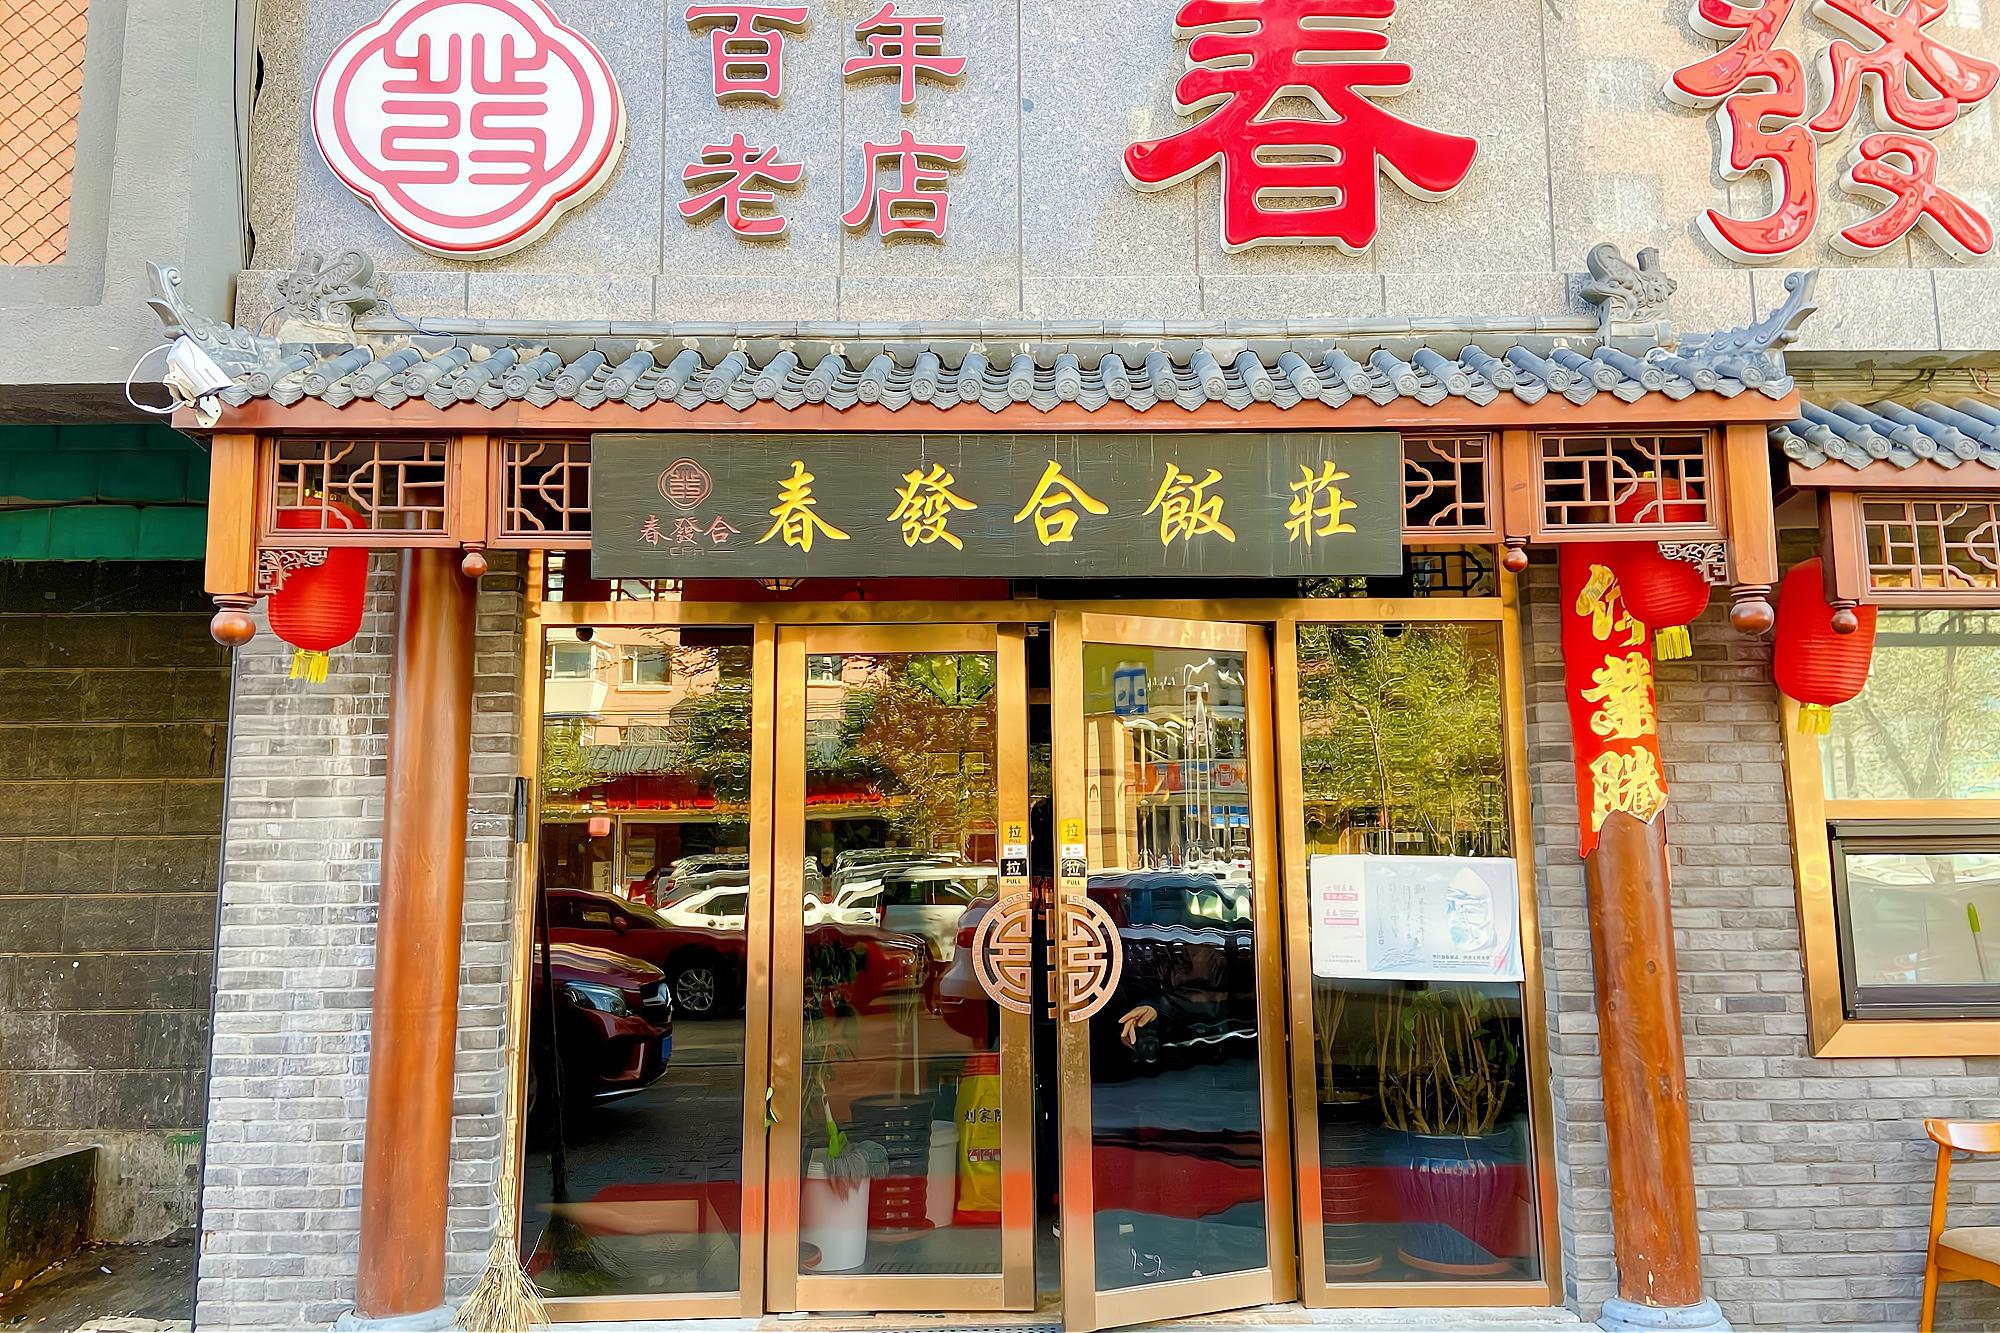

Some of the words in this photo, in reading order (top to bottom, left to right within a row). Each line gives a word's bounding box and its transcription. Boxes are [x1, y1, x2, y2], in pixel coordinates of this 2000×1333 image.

[684, 2, 969, 107] 百年
[677, 129, 968, 240] 老店
[755, 458, 1358, 553] 春發合飯莊
[637, 515, 741, 545] 春發合
[1009, 825, 1021, 838] 拉
[1066, 823, 1079, 837] 拉
[1006, 860, 1021, 876] 拉
[1067, 860, 1081, 876] 拉
